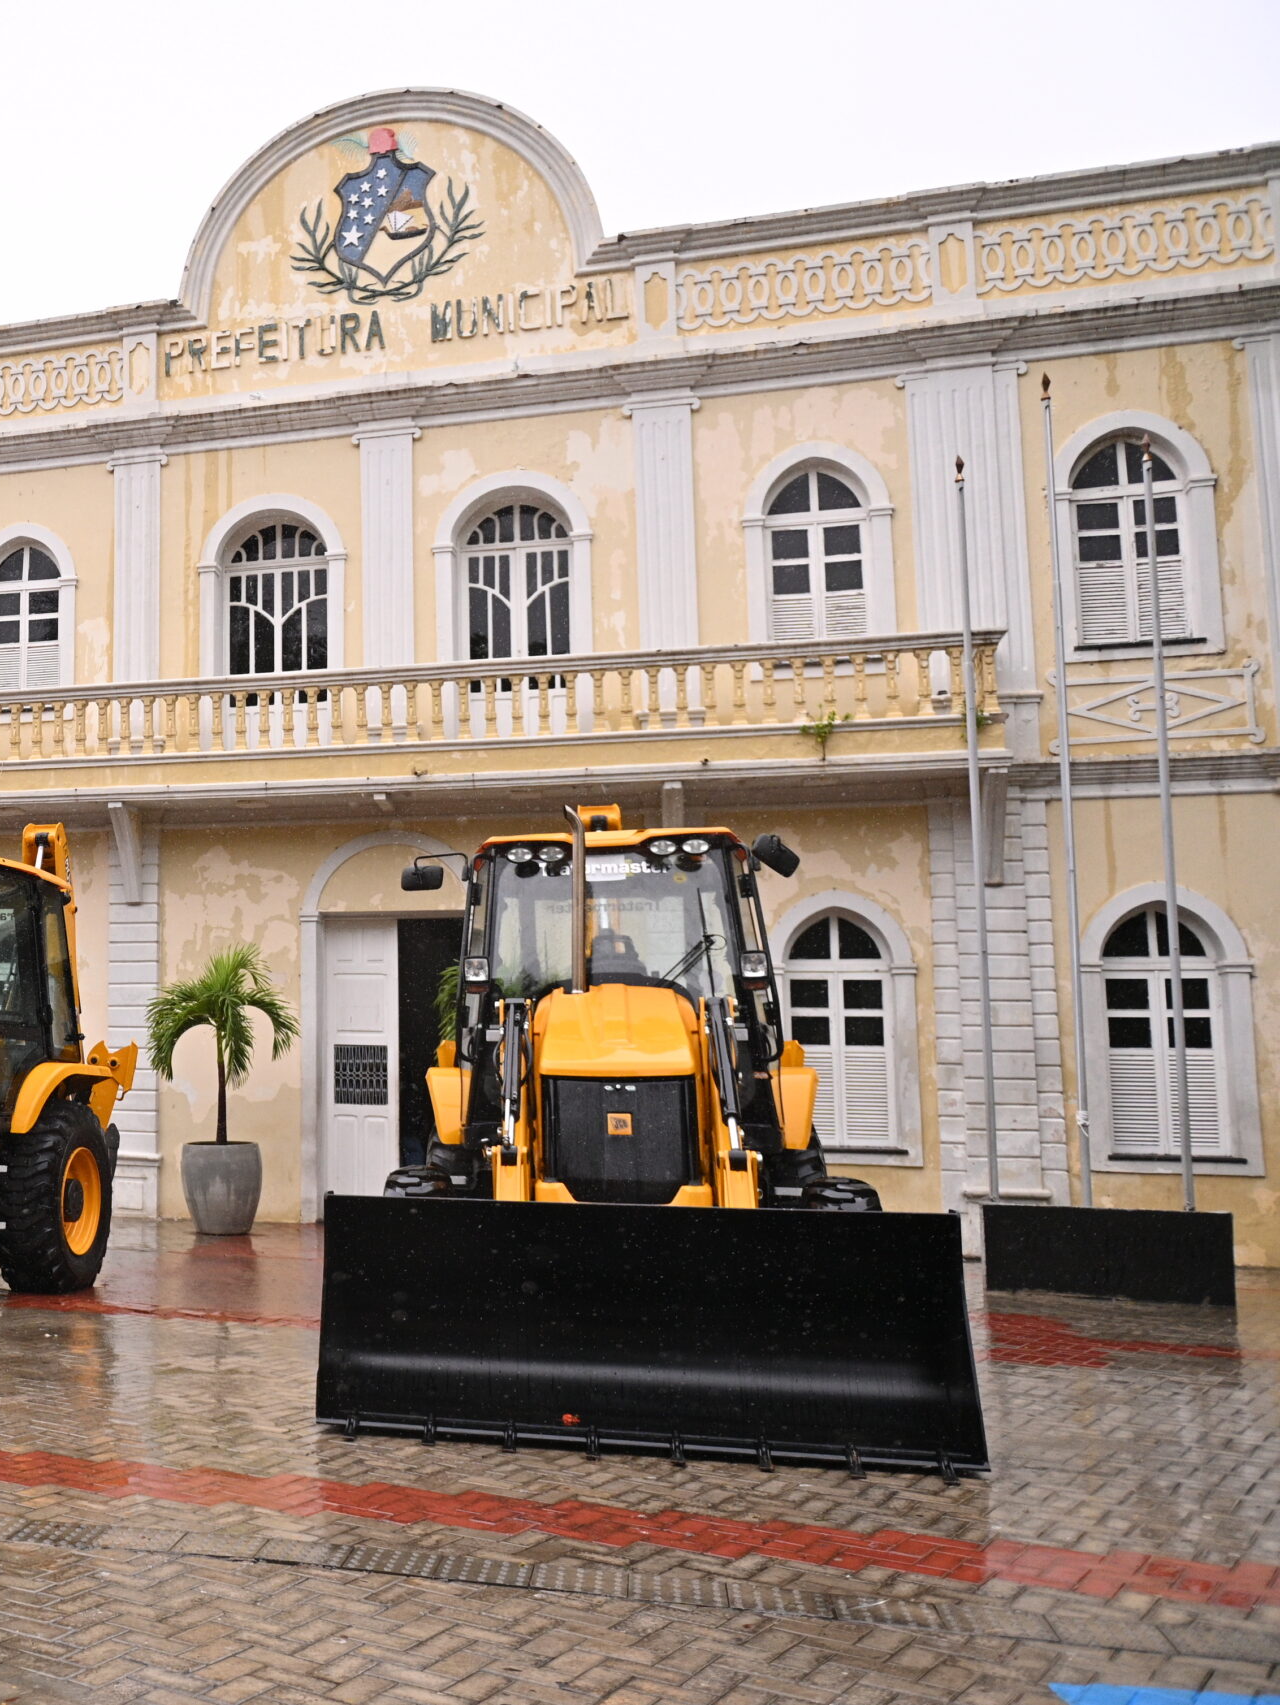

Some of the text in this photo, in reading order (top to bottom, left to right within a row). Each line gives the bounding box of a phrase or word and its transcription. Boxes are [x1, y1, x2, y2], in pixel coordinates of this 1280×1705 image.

[163, 277, 630, 377] PREFEITURA MUNICIPAL
[538, 860, 669, 877] Trarmaster
